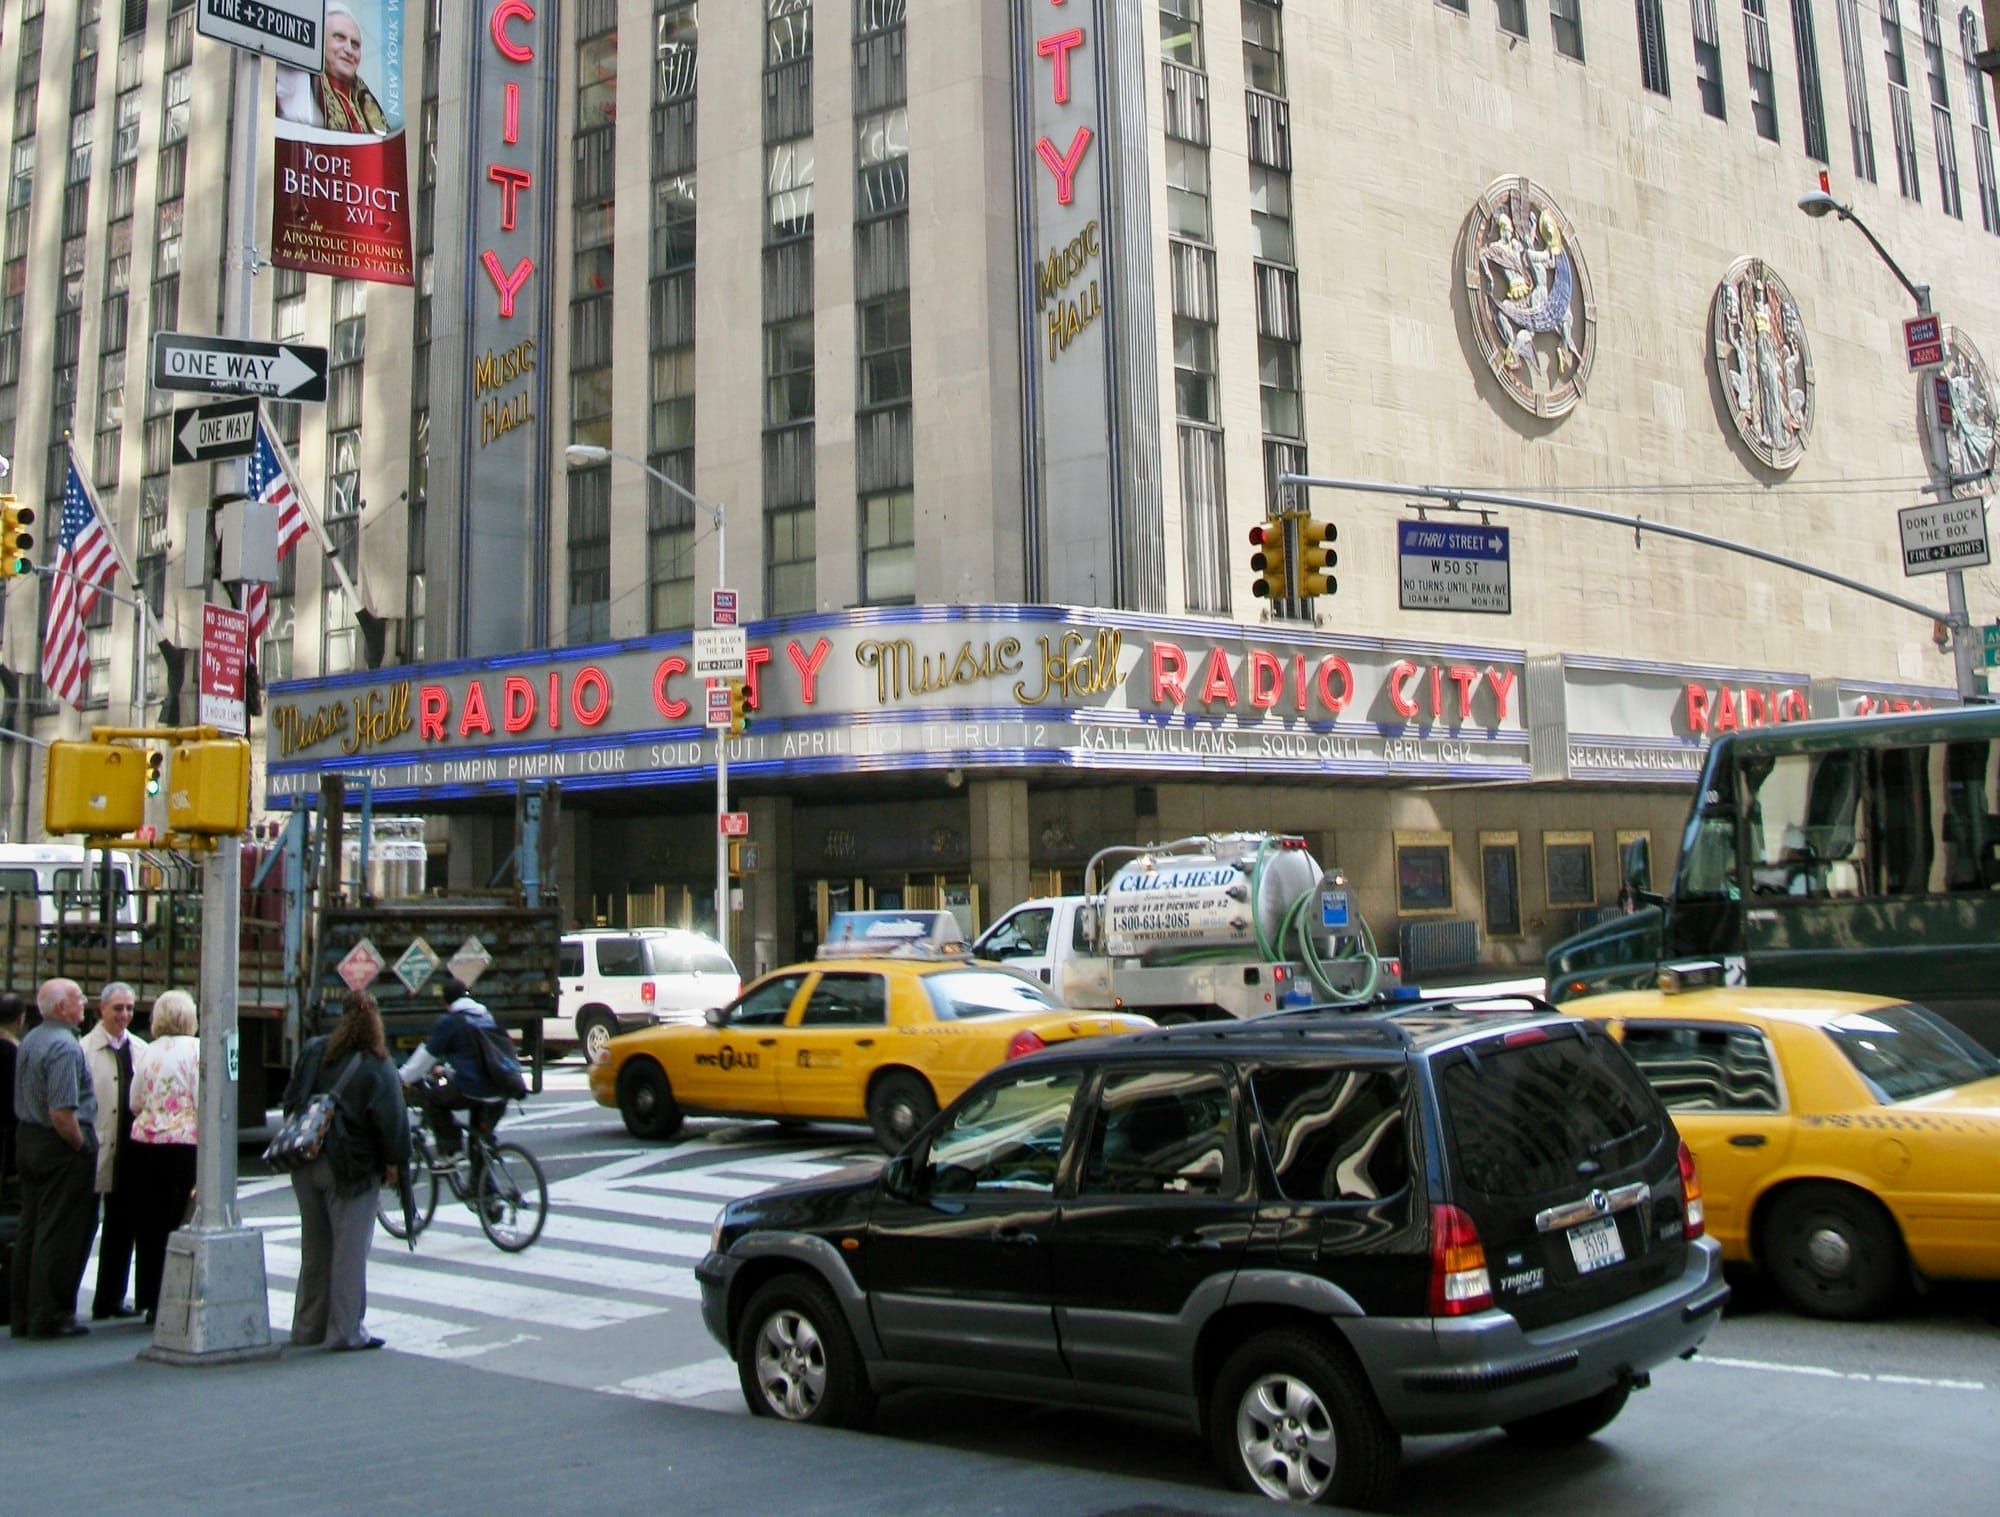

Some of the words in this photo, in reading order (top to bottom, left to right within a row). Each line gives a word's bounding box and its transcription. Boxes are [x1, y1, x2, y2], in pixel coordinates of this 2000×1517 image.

[213, 0, 242, 20] FINE
[267, 14, 311, 43] POINTS
[387, 20, 401, 66] YORK
[387, 77, 401, 117] NEW
[304, 149, 352, 177] POPE
[480, 0, 536, 319] CITY
[283, 167, 400, 212] BENEDICT
[309, 219, 324, 232] the
[346, 208, 375, 225] XVI
[282, 228, 350, 252] APOSTOLIC
[352, 240, 404, 259] JOURNEY
[282, 249, 293, 259] to
[294, 248, 310, 262] the
[311, 249, 361, 269] UNITED
[364, 257, 406, 275] STATES
[172, 351, 218, 376] ONE
[226, 356, 275, 381] WAY
[200, 420, 223, 444] ONE
[226, 415, 251, 440] WAY
[1906, 515, 1936, 530] DON'T
[1943, 508, 1978, 524] BLOCK
[1418, 531, 1446, 548] THRU
[1449, 533, 1485, 551] STREET
[1920, 528, 1940, 542] THE
[1946, 524, 1969, 538] BOX
[1910, 548, 1931, 563] FINE
[1949, 541, 1981, 556] POINTS
[1431, 559, 1440, 574] W
[1444, 560, 1461, 575] 50
[1465, 561, 1479, 576] ST
[1403, 578, 1415, 591] NO
[1418, 579, 1445, 592] TURNS
[1447, 581, 1468, 594] UNTIL
[1471, 582, 1492, 595] PARK
[1494, 583, 1507, 596] AVE
[206, 611, 215, 625] NO
[217, 614, 246, 633] STANDING
[213, 629, 237, 644] ANYTIME
[706, 647, 718, 656] THE
[721, 646, 735, 655] BOX
[856, 636, 1024, 705] Music
[1013, 628, 1127, 705] Hall
[418, 666, 611, 742] RADIO
[653, 637, 832, 720] CTY
[1151, 640, 1355, 713] RADIO
[1389, 658, 1516, 720] CITY
[272, 700, 348, 758] Music
[340, 680, 415, 754] Hall
[406, 764, 433, 785] IT'S
[443, 760, 497, 782] PIMPIN
[508, 752, 566, 778] PIMPIN
[578, 750, 626, 772] TOUR
[651, 743, 701, 768] SOLD
[783, 731, 843, 756] APRIL
[870, 726, 900, 747] 10
[926, 724, 1001, 749] THRU
[1023, 724, 1046, 745] 12
[1080, 726, 1131, 750] KATT
[1146, 729, 1238, 754] WILLIAMS
[1261, 734, 1308, 757] SOLD
[1383, 739, 1427, 762] APRIL
[1436, 742, 1473, 763] 10-12
[1569, 747, 1626, 767] SPEAKER
[1634, 749, 1675, 769] SERIES
[271, 774, 308, 794] KATT
[1119, 869, 1236, 892] CALL-A-HEAD
[1113, 904, 1139, 915] WE'RE
[1153, 903, 1165, 912] AT
[1166, 901, 1200, 911] PICKING
[1202, 900, 1216, 909] UP
[1113, 912, 1190, 932] 1-800-634-2085
[1500, 1268, 1545, 1292] TRIBUTE
